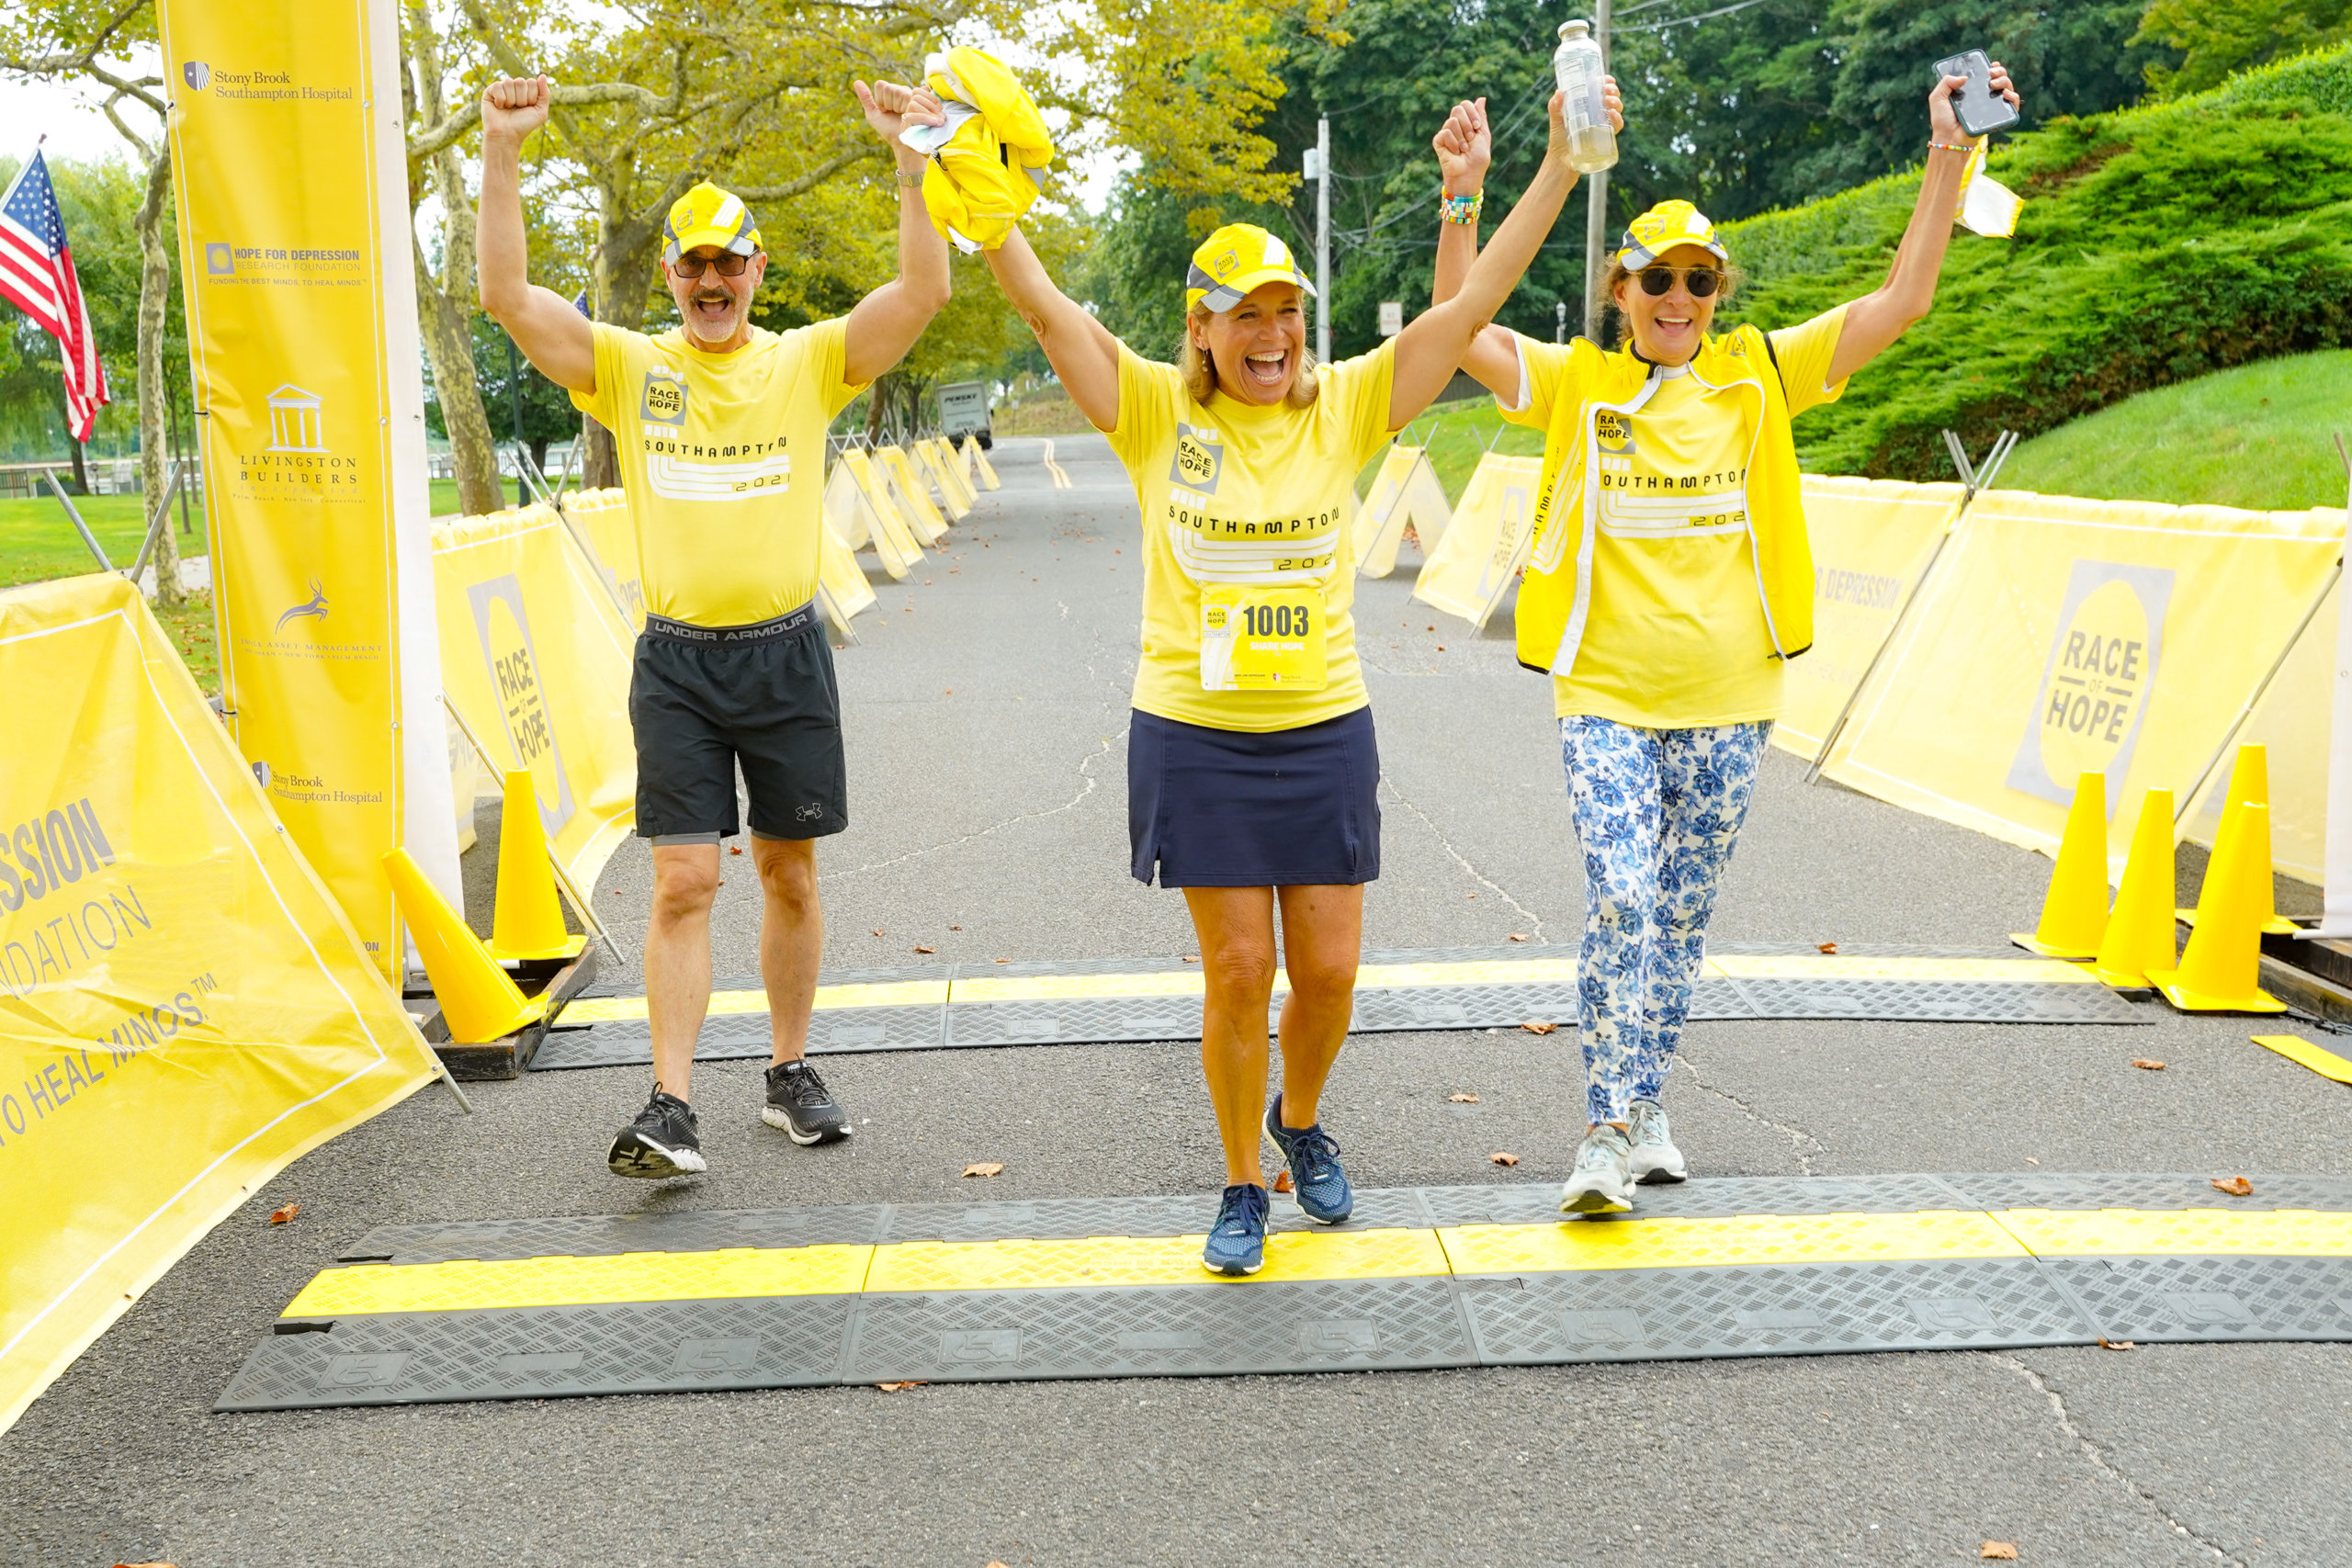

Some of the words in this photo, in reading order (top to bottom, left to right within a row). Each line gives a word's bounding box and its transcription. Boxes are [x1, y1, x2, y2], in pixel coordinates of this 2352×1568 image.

[215, 71, 251, 86] Stony
[254, 71, 290, 84] Brook
[215, 86, 300, 102] Southampton
[301, 86, 353, 102] Hospital
[235, 248, 262, 260] HOPE
[265, 249, 287, 261] FOR
[290, 250, 360, 261] DEPRESSION
[237, 261, 290, 271] RESEARCH
[294, 262, 360, 272] FOUNDATION
[650, 386, 680, 400] RACE
[649, 400, 680, 412] HOPE
[241, 456, 356, 468] LIVINGSTON
[1180, 441, 1212, 467] RACE
[1180, 457, 1211, 478] HOPE
[241, 471, 356, 484] BUILDERS
[1603, 468, 1746, 489] OUTHAMPTO
[1169, 505, 1340, 535] SOUTHAMPTON
[1279, 548, 1336, 570] 202
[1825, 569, 1903, 610] DEPRESSION
[655, 621, 718, 641] UNDER
[724, 614, 808, 641] ARMOUR
[1243, 604, 1308, 637] 1003
[266, 641, 298, 649] ASSET
[1250, 641, 1279, 650] SHARE
[1281, 641, 1305, 650] HOPE
[2064, 630, 2143, 682] RACE
[2089, 679, 2102, 693] OF
[2046, 689, 2128, 744] HOPE
[290, 775, 323, 787] Brook
[274, 785, 331, 804] Southampton
[333, 790, 382, 805] Hospital
[0, 797, 118, 918] SSION
[362, 941, 379, 952] ON
[0, 1093, 26, 1147] O
[24, 1048, 105, 1121] HEAL
